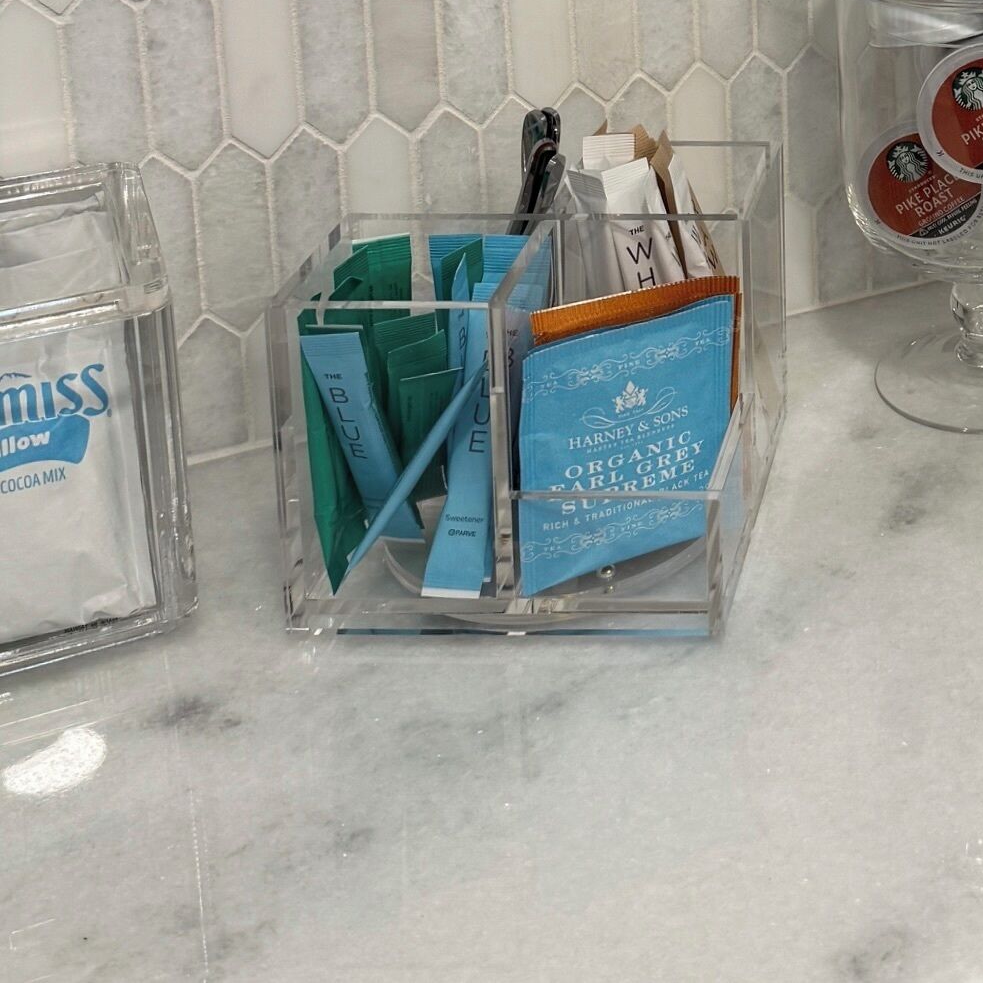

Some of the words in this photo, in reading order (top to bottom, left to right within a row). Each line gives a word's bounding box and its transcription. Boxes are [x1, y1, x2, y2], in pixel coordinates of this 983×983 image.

[895, 192, 924, 215] PIKE
[914, 187, 953, 217] ROAST
[943, 197, 965, 215] COFFEE
[628, 225, 645, 236] THE
[937, 214, 967, 236] KEURIG
[324, 373, 343, 381] THE
[328, 387, 368, 460] BLUE
[569, 425, 635, 450] HARNEY
[638, 419, 650, 433] &
[653, 404, 689, 425] SONS
[0, 431, 51, 457] llow
[565, 431, 691, 479] ORGANIC
[636, 439, 705, 474] GREY
[0, 473, 41, 494] COCOA
[43, 466, 66, 485] MIX
[543, 520, 569, 531] RICH
[585, 498, 652, 522] TRADITIONA
[694, 471, 709, 482] TEA
[446, 514, 484, 524] Sweetener
